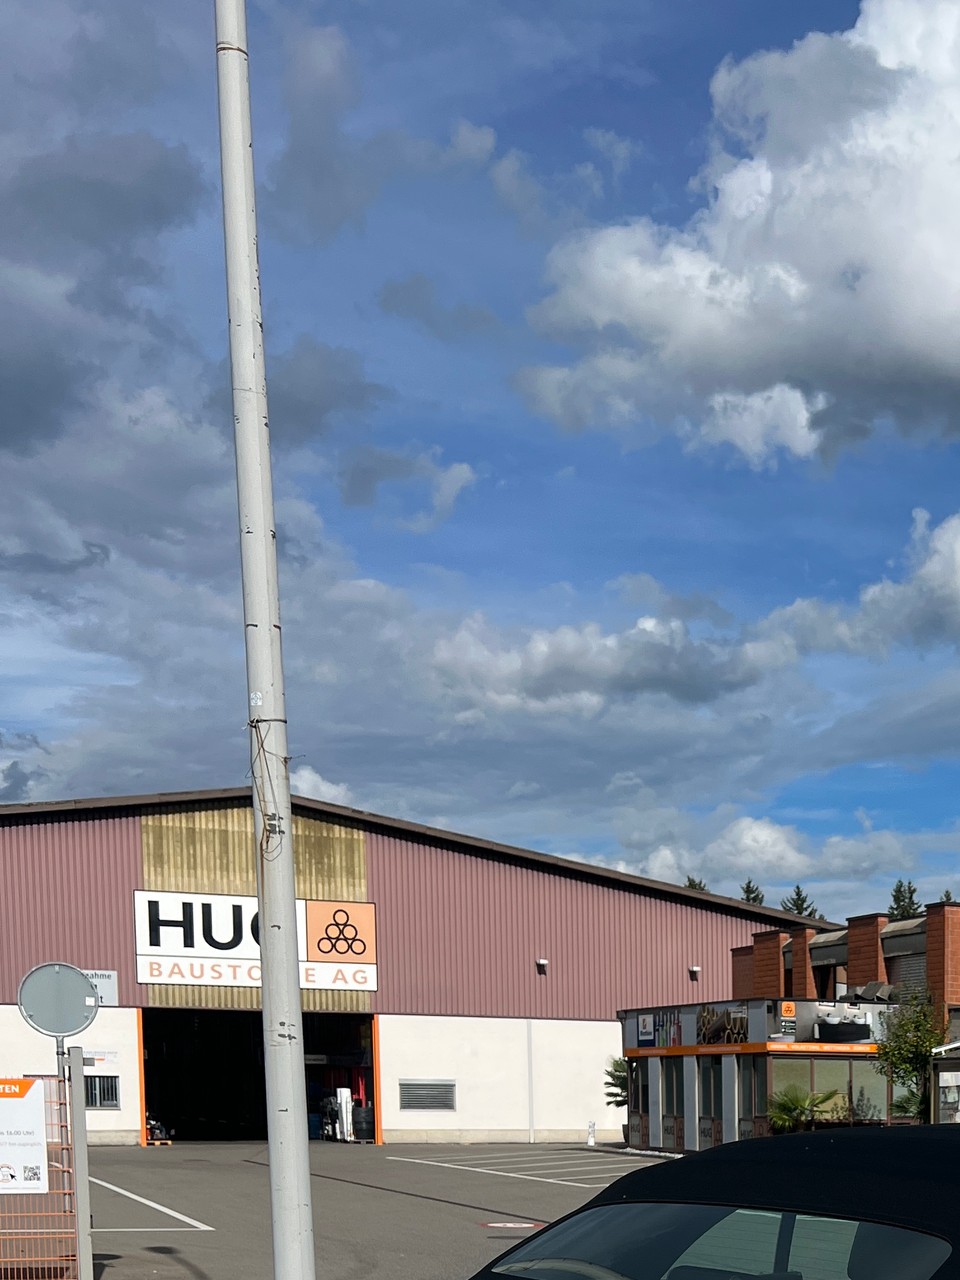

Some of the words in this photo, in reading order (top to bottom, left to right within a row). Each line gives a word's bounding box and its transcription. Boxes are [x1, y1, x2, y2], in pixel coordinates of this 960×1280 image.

[148, 900, 261, 950] HU
[148, 962, 316, 984] BAUSTOE
[332, 968, 368, 985] AG
